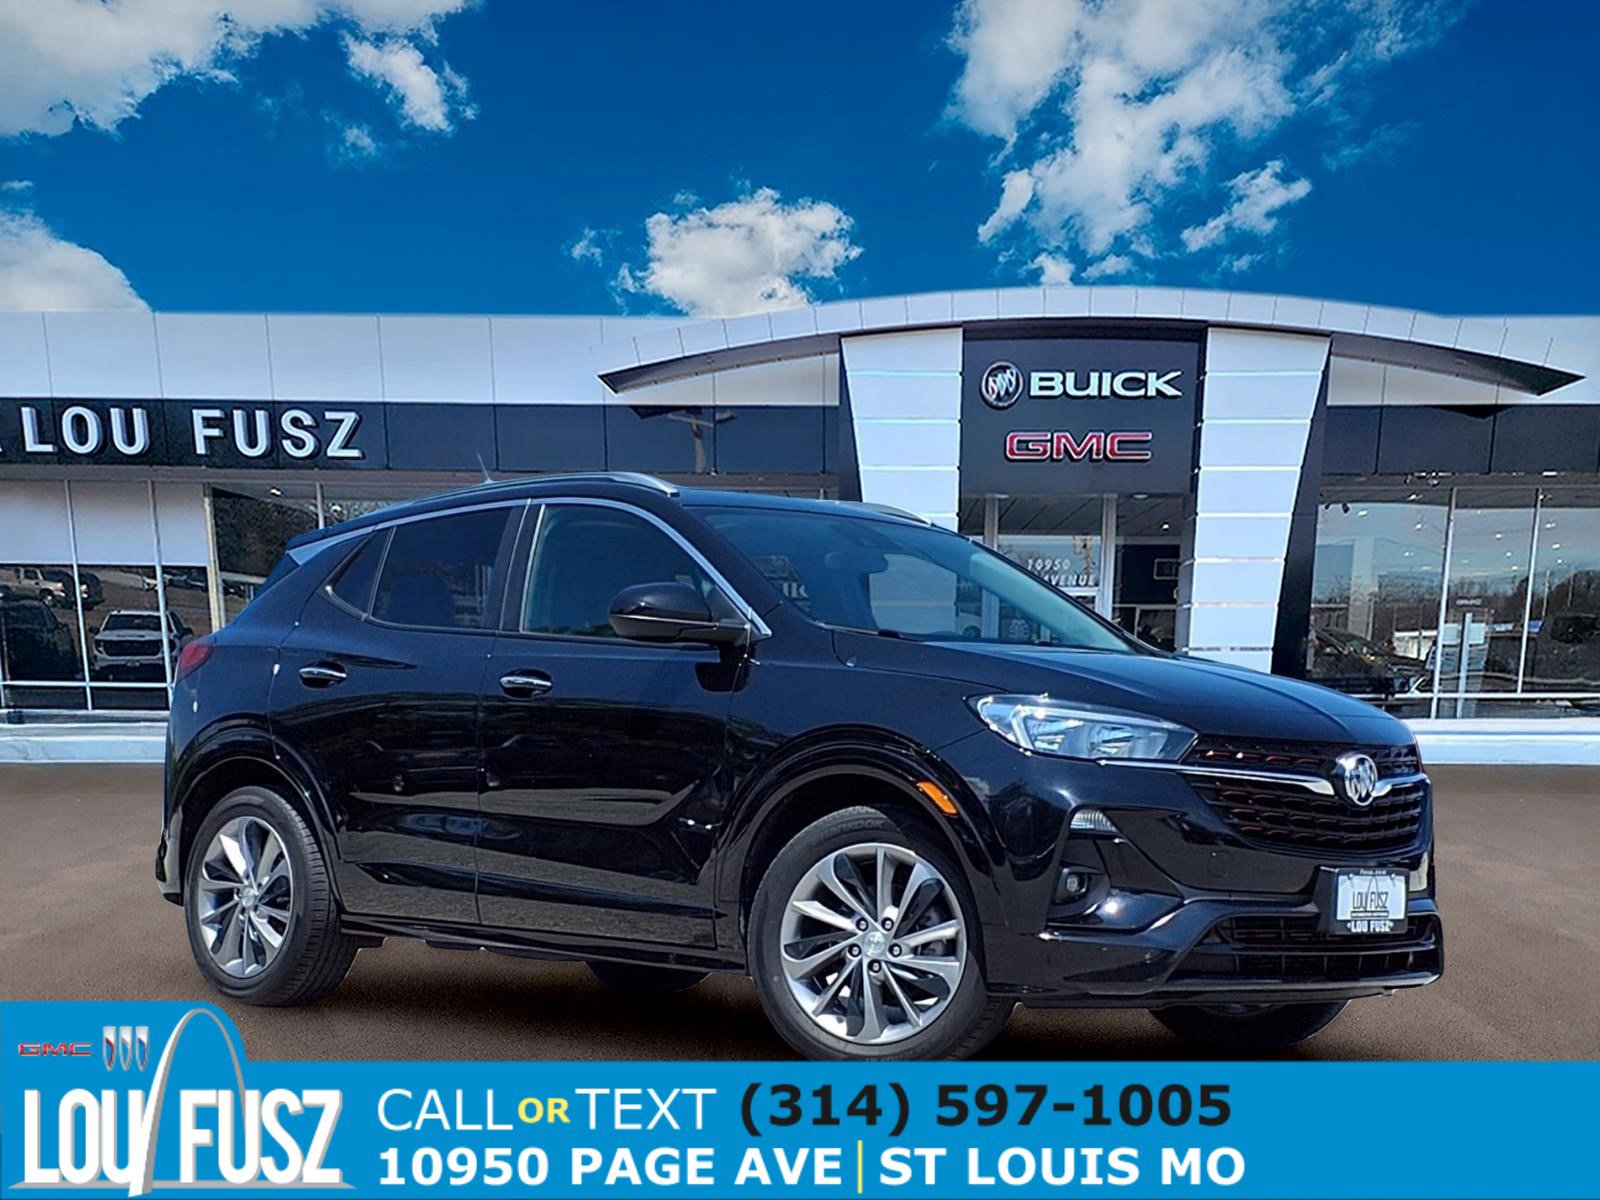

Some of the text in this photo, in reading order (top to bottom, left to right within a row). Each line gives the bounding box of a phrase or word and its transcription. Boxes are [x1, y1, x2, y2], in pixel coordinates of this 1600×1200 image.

[1029, 371, 1183, 397] BUICK
[21, 406, 362, 458] LOU FUSZ
[1005, 431, 1152, 460] GMC
[1027, 558, 1072, 571] 10950
[1351, 920, 1391, 932] LOU FUSZ
